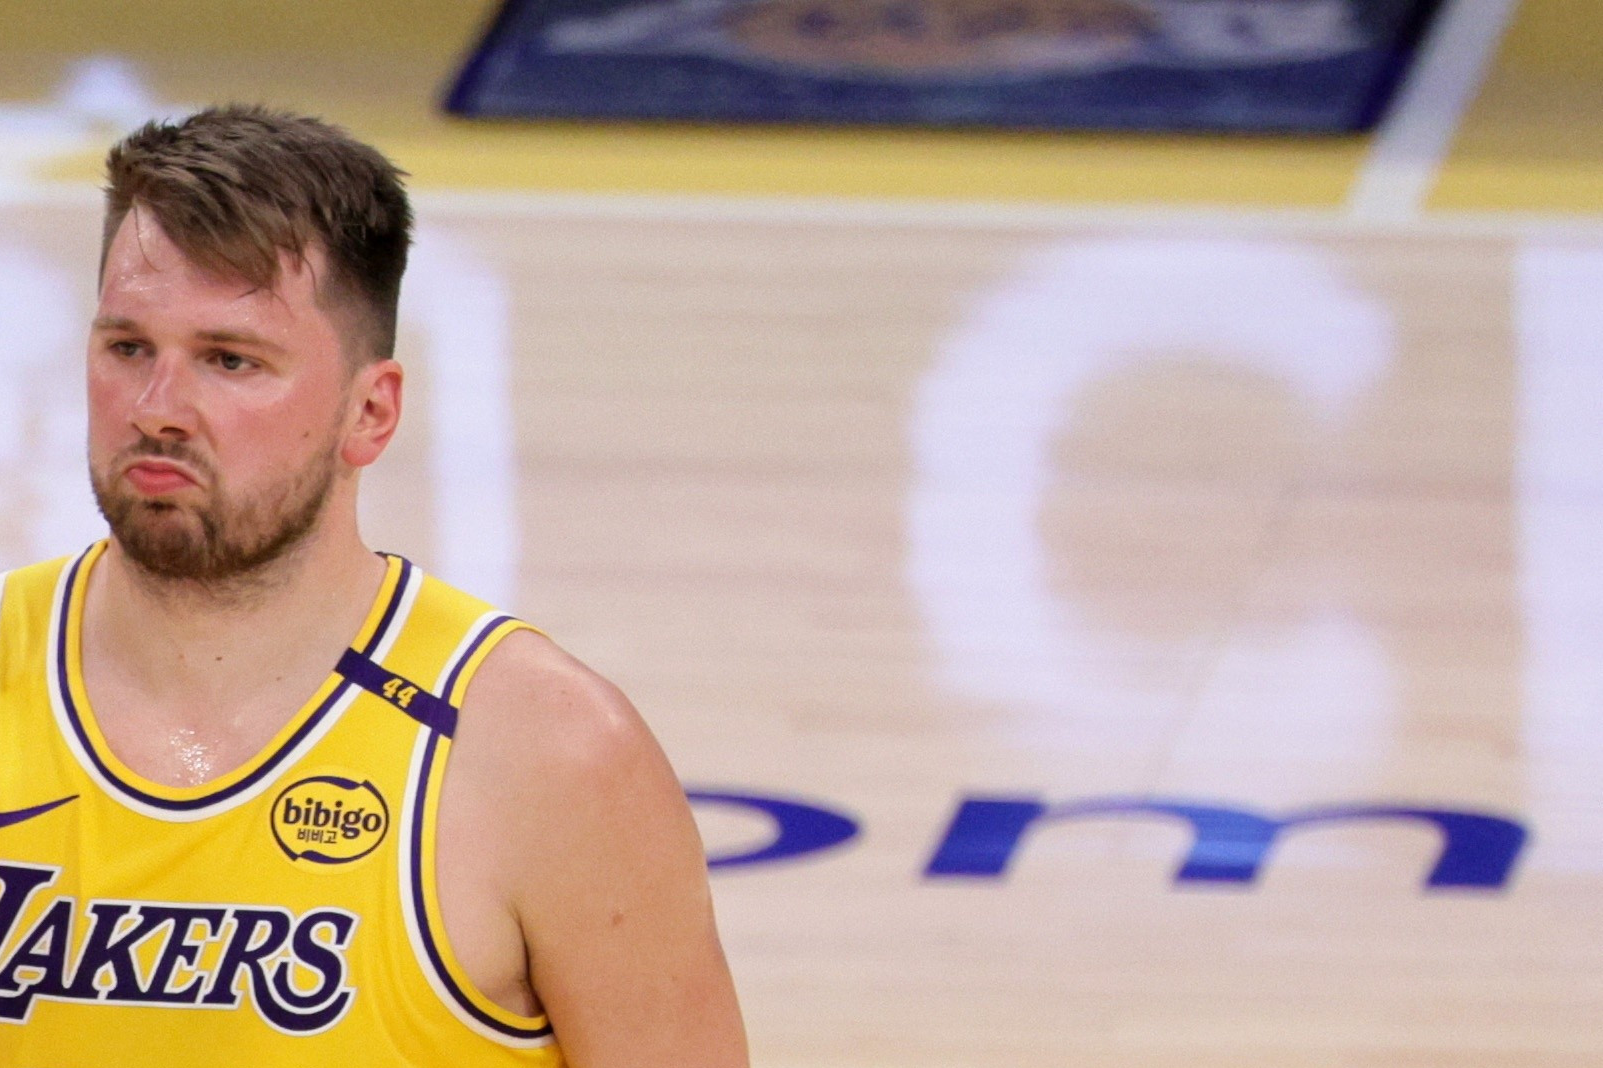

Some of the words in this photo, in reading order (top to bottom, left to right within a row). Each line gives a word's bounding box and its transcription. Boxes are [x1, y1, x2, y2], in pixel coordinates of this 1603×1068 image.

[381, 678, 418, 708] 44
[283, 797, 382, 840] bibigo
[296, 828, 337, 844] 비비고
